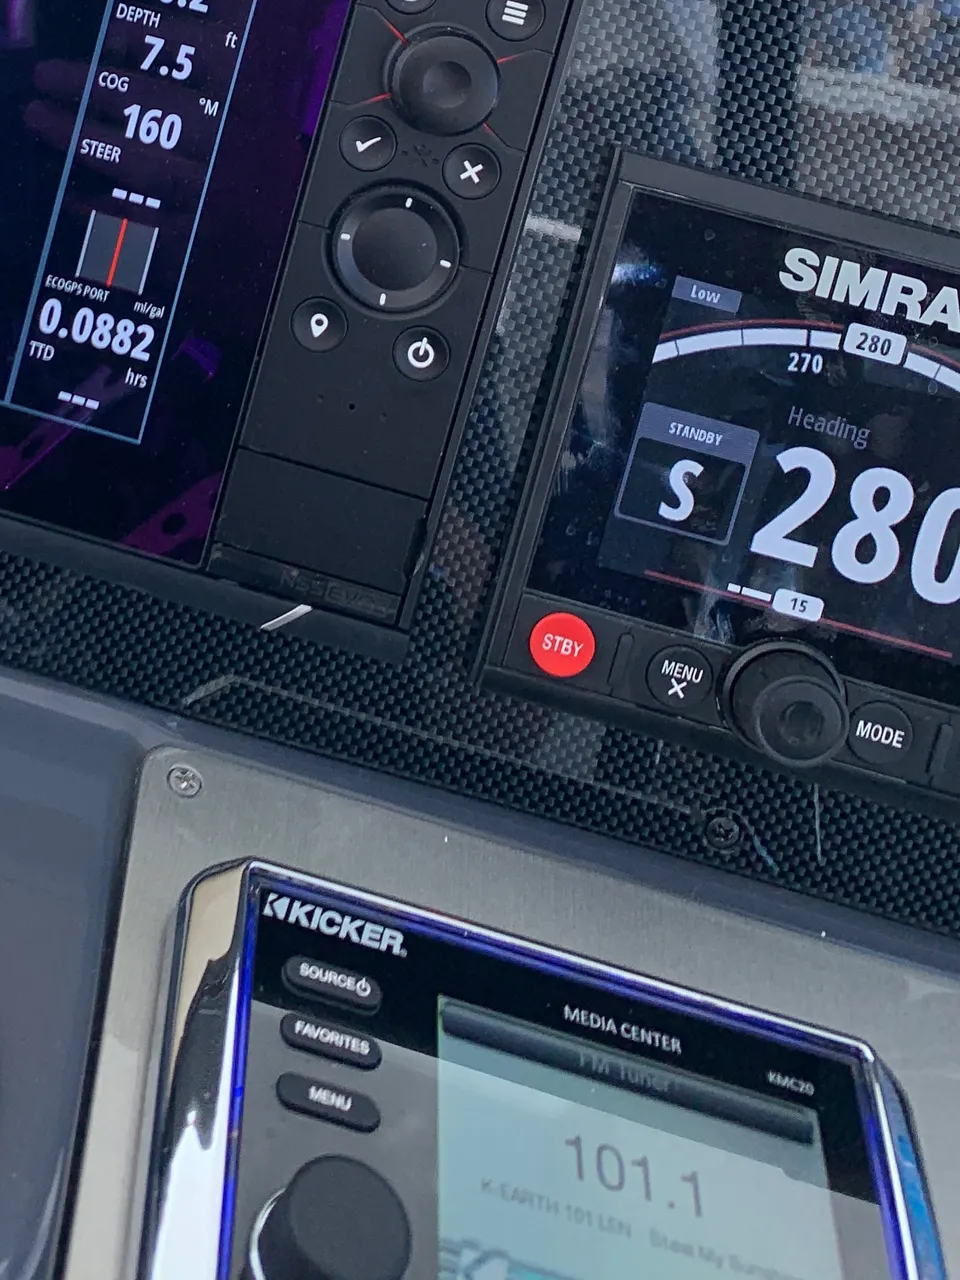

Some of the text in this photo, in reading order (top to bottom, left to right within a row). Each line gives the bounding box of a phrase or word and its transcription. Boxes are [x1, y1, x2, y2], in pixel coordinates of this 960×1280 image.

[116, 3, 161, 28] DEPTH
[224, 31, 238, 49] ft
[140, 35, 196, 80] 7.5
[98, 71, 130, 93] COG
[123, 104, 182, 150] 160
[80, 139, 122, 163] STEER
[44, 274, 110, 302] ECOGPS PORT
[133, 300, 165, 319] mi/gal
[39, 298, 155, 362] 0.0882
[29, 340, 55, 362] TTD
[855, 332, 892, 356] 280
[788, 352, 823, 374] 270
[124, 368, 148, 388] hrs
[668, 421, 723, 447] STANDBY
[788, 406, 871, 450] Heading
[658, 459, 704, 521] S
[750, 446, 960, 604] 280
[791, 598, 808, 612] 15
[541, 633, 585, 658] STBY
[661, 660, 704, 684] MENU
[855, 719, 906, 749] MODE
[288, 904, 405, 957] KICKER
[299, 962, 356, 992] SOURCE
[294, 1020, 370, 1056] FAVORITES
[563, 1004, 682, 1055] MEDIA CENTER
[308, 1086, 353, 1111] MENU
[565, 1133, 704, 1219] 101.1
